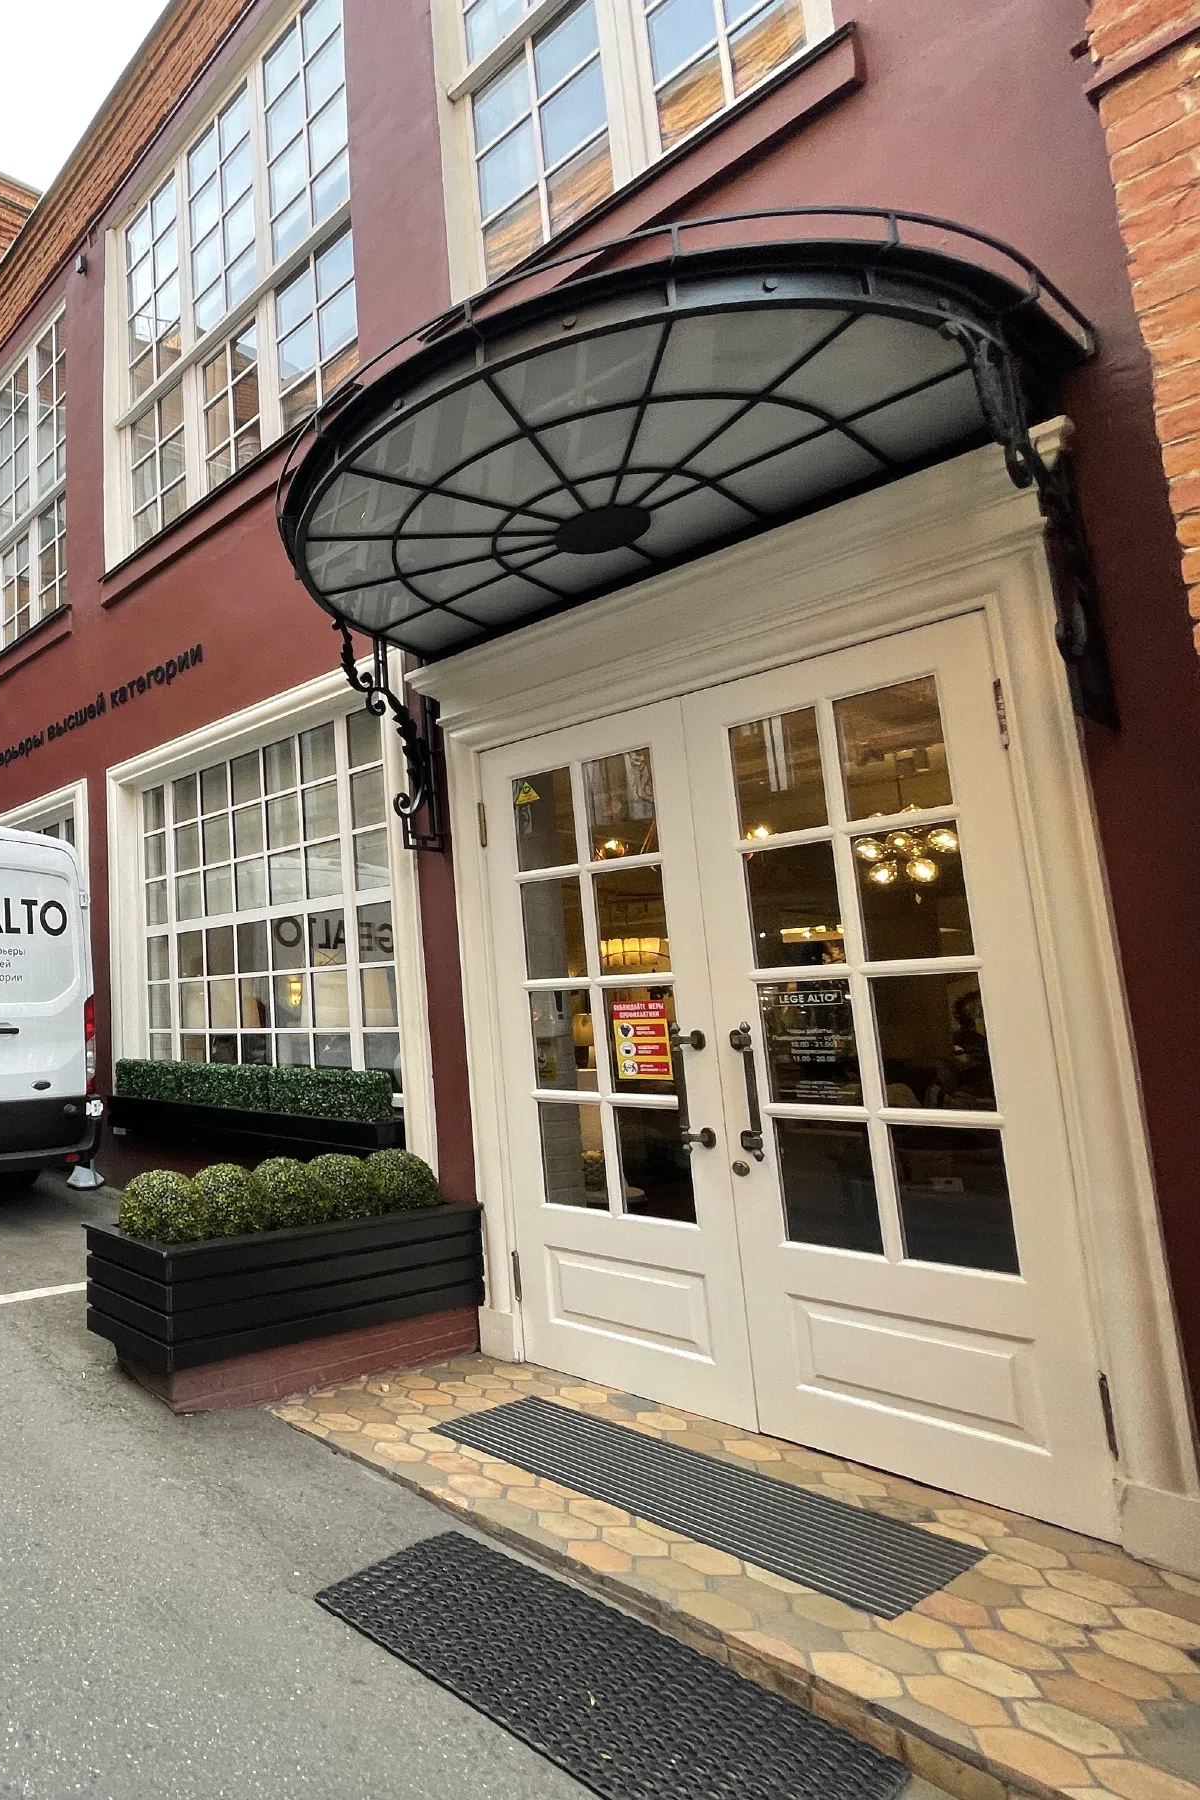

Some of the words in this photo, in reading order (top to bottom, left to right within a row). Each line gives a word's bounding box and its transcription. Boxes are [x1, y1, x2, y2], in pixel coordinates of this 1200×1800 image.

[47, 692, 106, 741] высшей
[110, 643, 204, 709] категории
[779, 994, 805, 1004] LEGE
